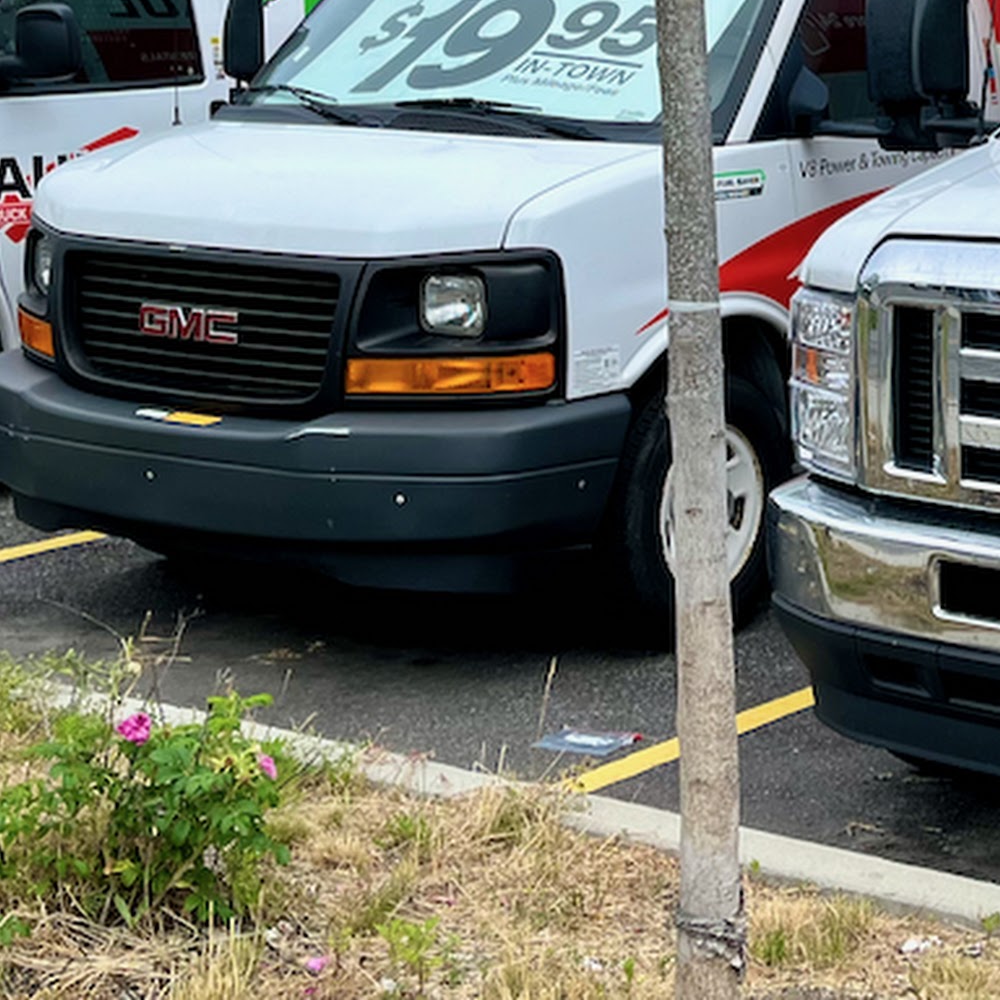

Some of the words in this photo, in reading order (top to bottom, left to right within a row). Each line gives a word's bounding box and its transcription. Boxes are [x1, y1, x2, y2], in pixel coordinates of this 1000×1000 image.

[514, 57, 636, 85] IN-TOWN
[819, 158, 857, 176] Power
[859, 153, 869, 170] &
[140, 302, 238, 345] GMC
